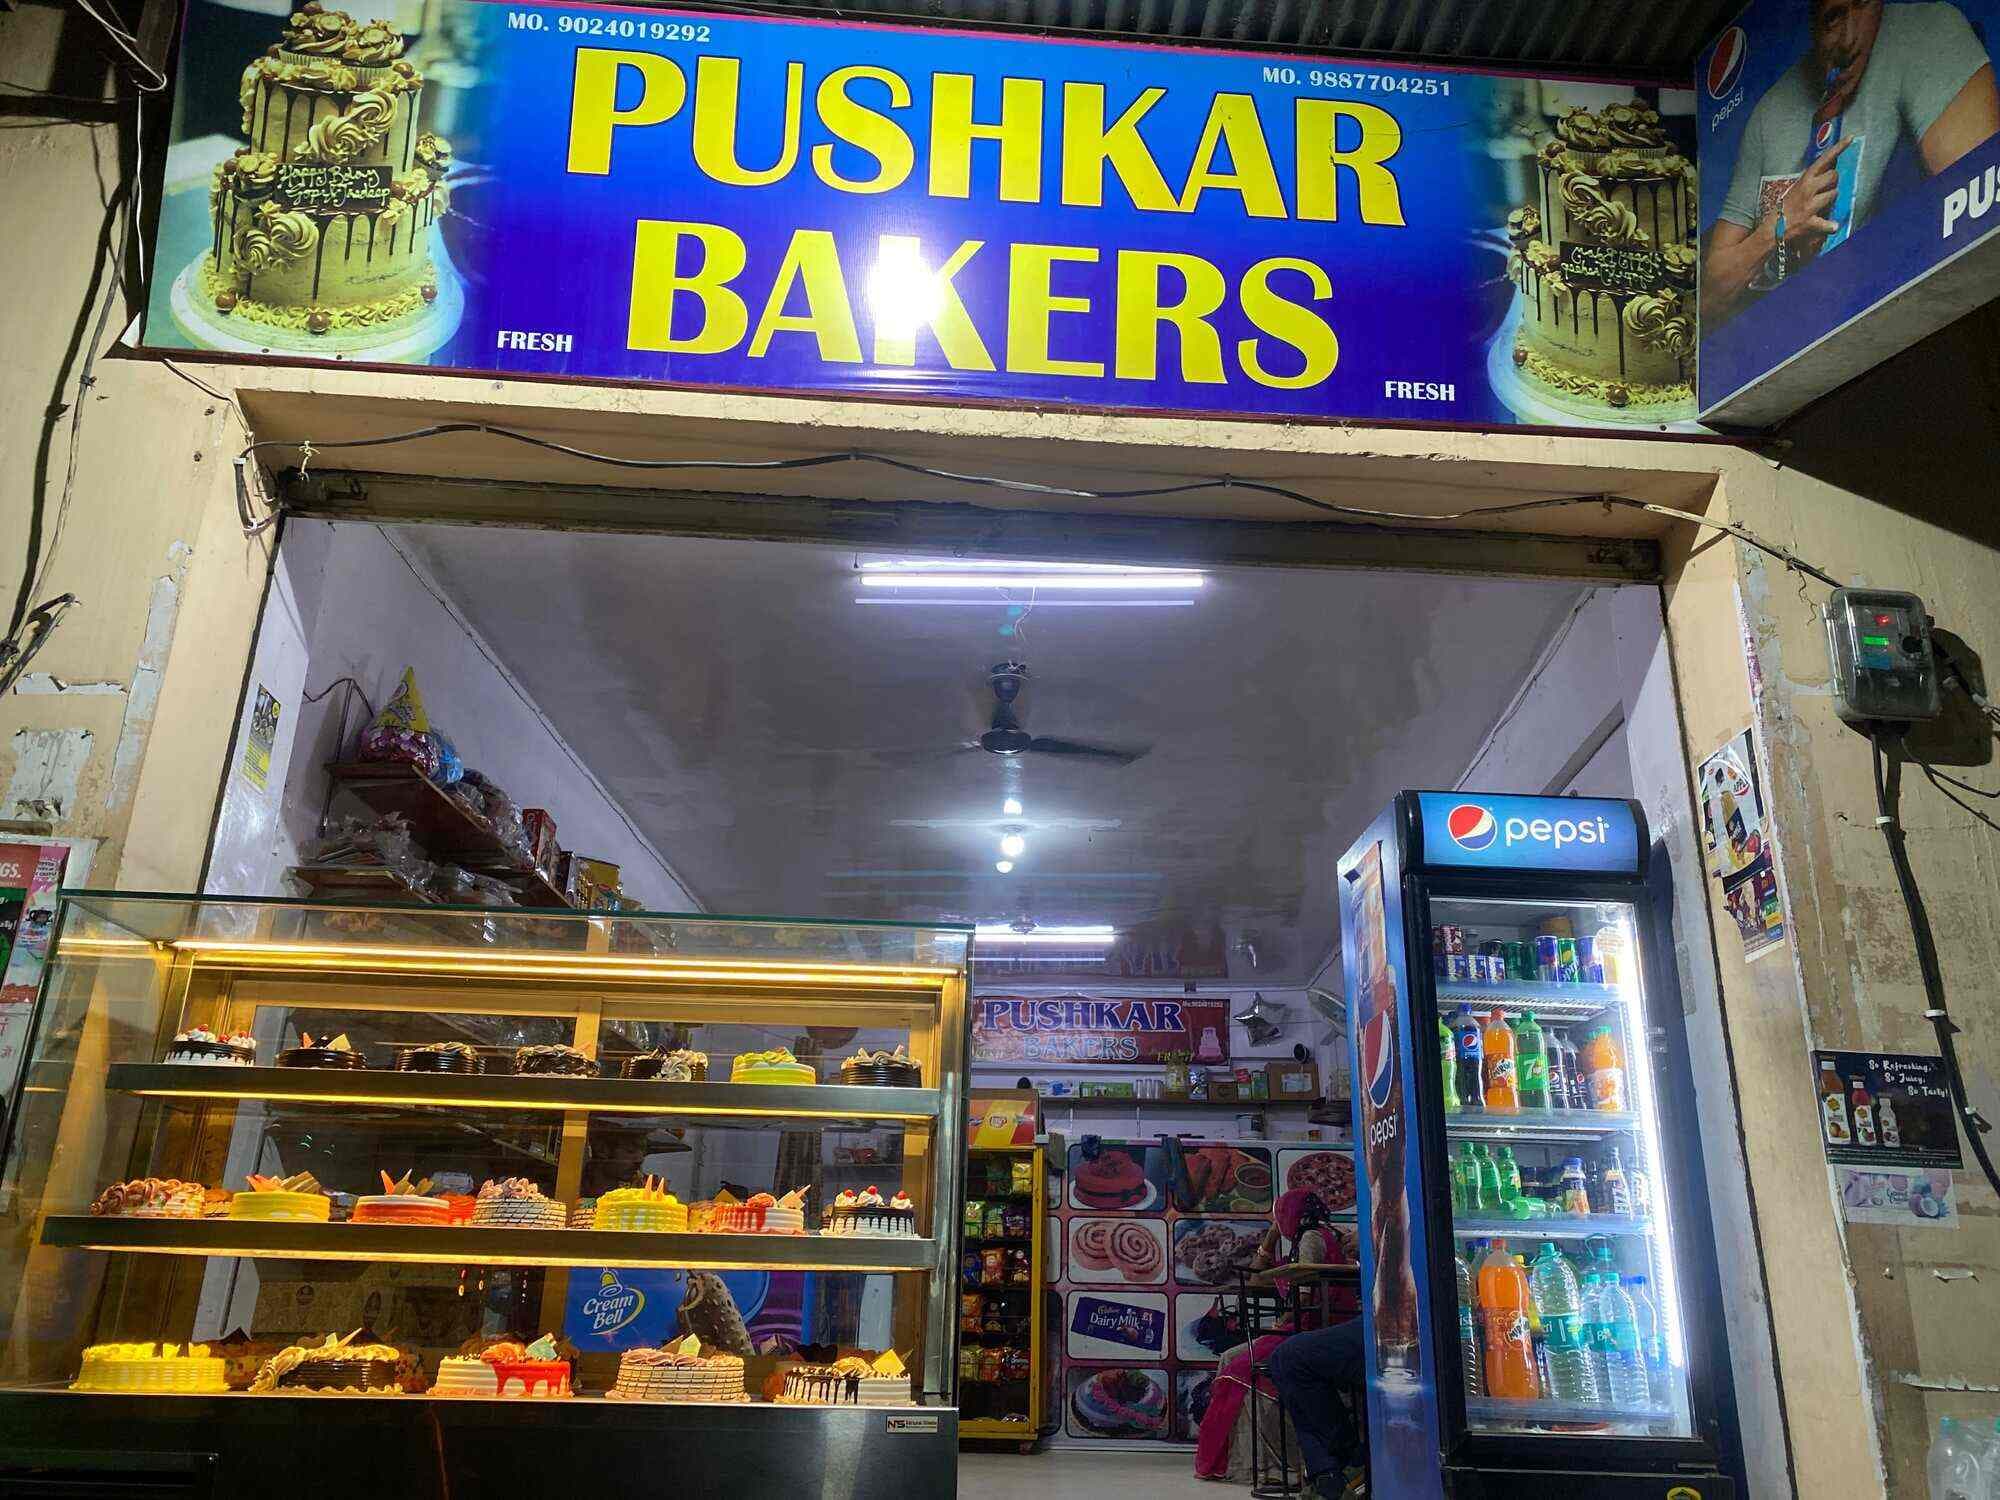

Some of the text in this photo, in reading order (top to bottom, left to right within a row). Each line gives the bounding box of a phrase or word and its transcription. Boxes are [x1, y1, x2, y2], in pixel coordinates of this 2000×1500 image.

[508, 12, 710, 42] MO. 9024019292
[1263, 67, 1450, 96] MO. 9887704251
[1712, 87, 1744, 132] pepsi
[567, 47, 1406, 226] PUSHKAR
[1943, 164, 2000, 239] PU
[626, 219, 1339, 389] BAKERS
[497, 330, 573, 352] FRESH
[1385, 380, 1455, 401] FRESH
[1505, 816, 1607, 849] pepsi
[983, 1000, 1185, 1032] PUSHKAR
[1024, 1036, 1138, 1060] BAKERS
[1370, 1107, 1397, 1151] pepsi
[583, 1294, 634, 1316] Cream
[593, 1308, 623, 1330] Bell
[1090, 1312, 1140, 1330] Dairy Milk
